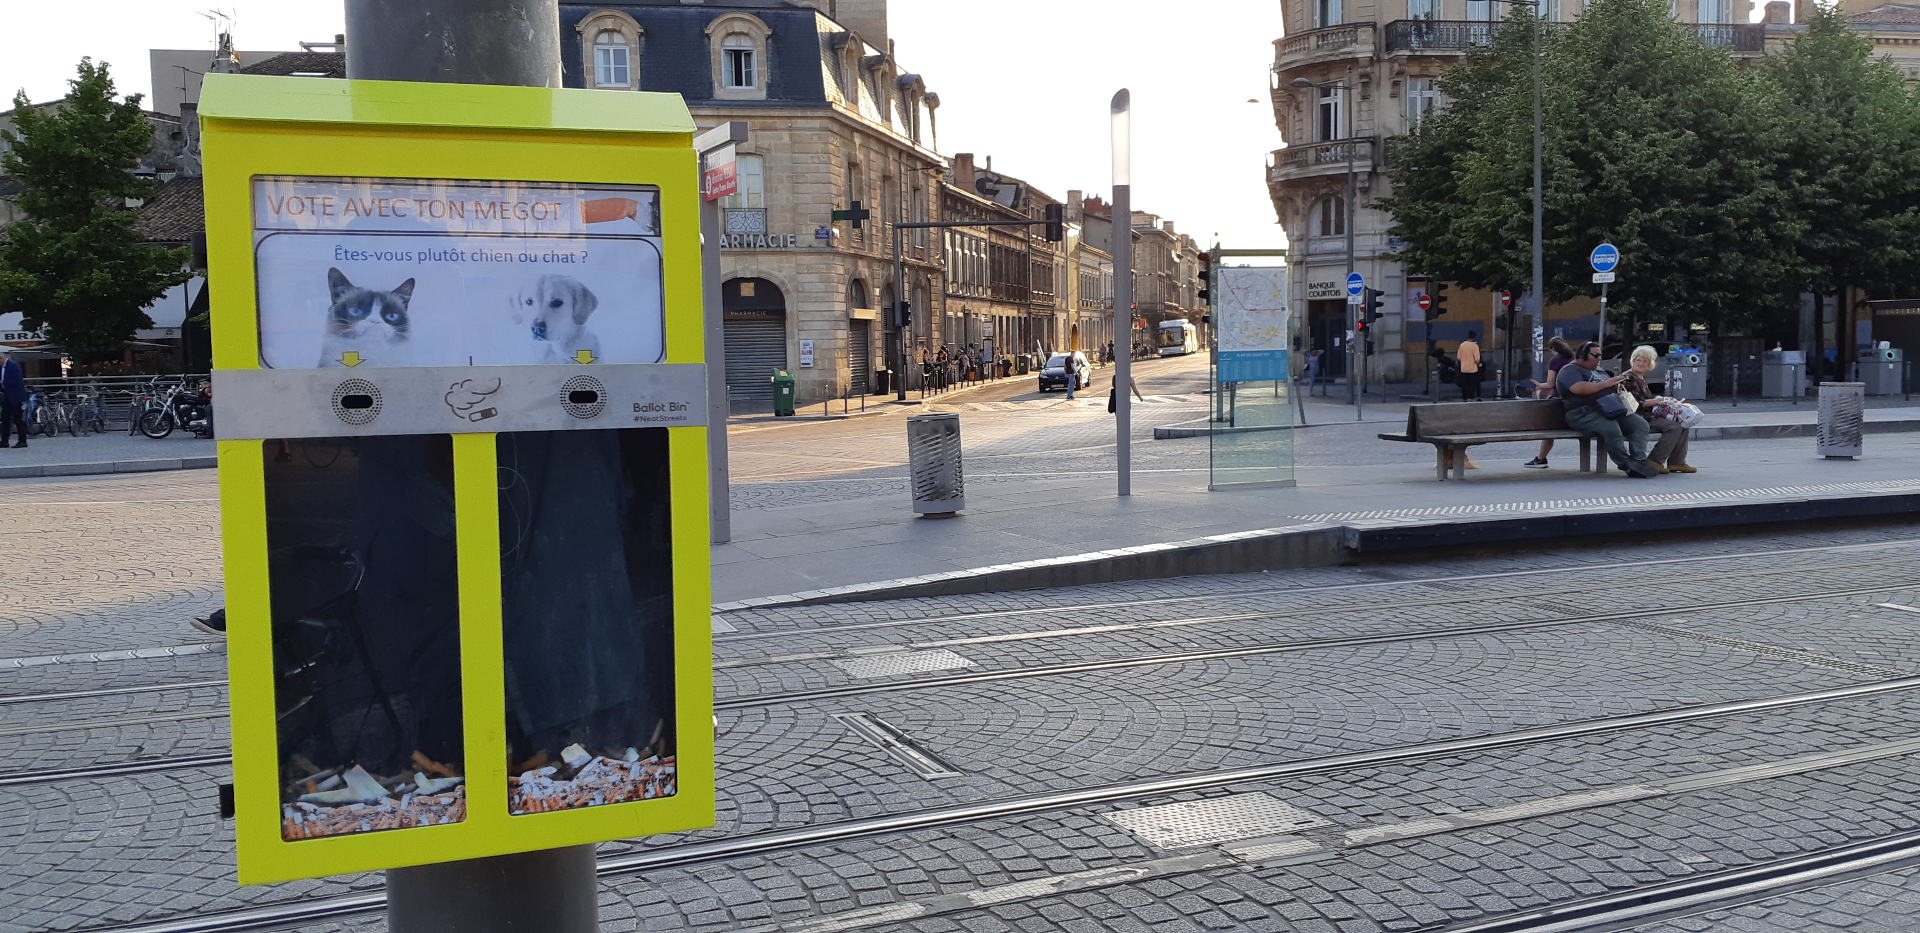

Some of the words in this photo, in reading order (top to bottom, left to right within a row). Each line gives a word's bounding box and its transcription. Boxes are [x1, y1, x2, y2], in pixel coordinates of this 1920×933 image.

[267, 195, 335, 217] VOTE
[343, 197, 407, 218] AVEC
[413, 199, 466, 219] TON
[474, 200, 563, 221] MEGOT
[334, 244, 413, 262] Êtes-vous
[418, 247, 466, 264] plutôt
[471, 248, 513, 263] chien
[518, 253, 538, 263] ou
[543, 250, 576, 264] chat
[580, 250, 588, 263] ?
[1308, 281, 1336, 290] BANQUE
[1308, 289, 1341, 298] COURTOIS
[633, 402, 666, 413] Ballot
